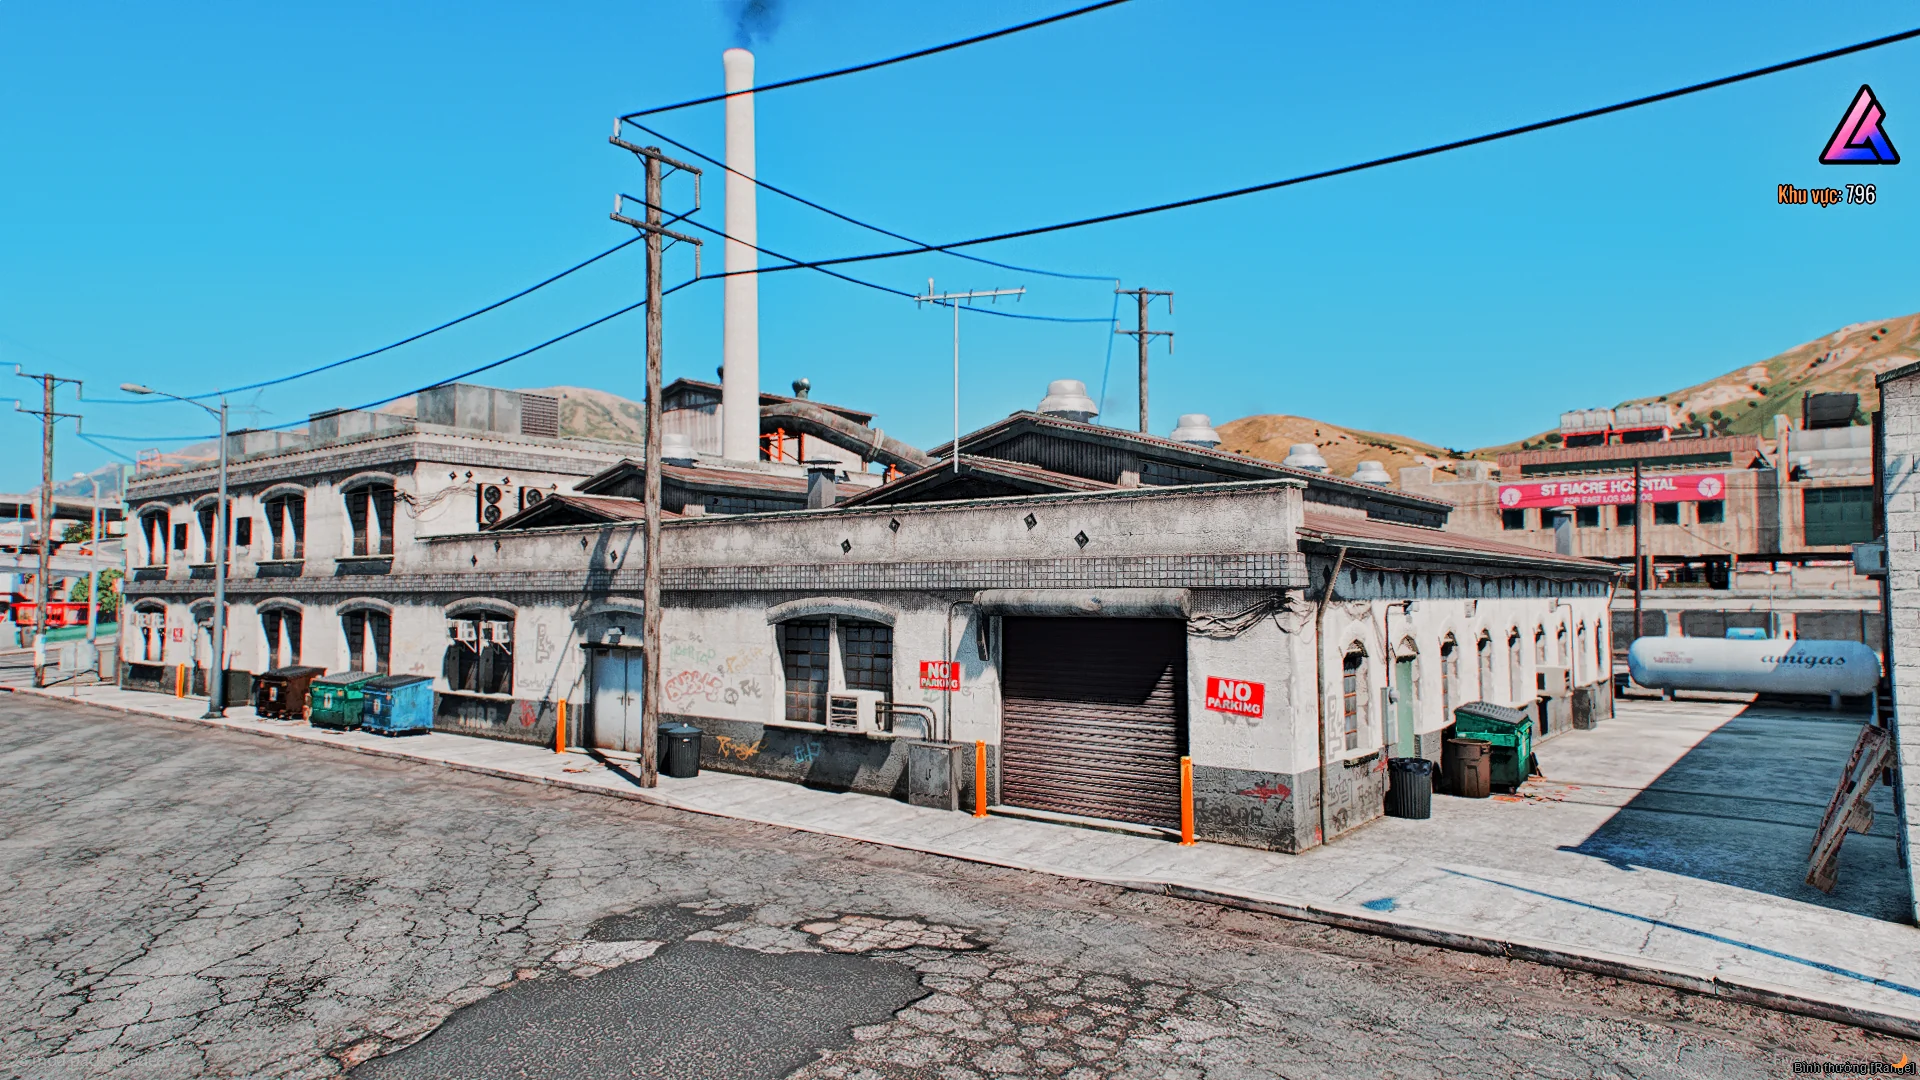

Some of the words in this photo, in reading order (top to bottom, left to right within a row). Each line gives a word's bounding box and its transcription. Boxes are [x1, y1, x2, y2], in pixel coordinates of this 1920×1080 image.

[1541, 484, 1557, 496] ST
[1560, 481, 1608, 495] FIACRE
[1563, 497, 1580, 505] FOR
[1582, 495, 1600, 504] EAST
[1603, 494, 1619, 503] LOS
[928, 662, 951, 679] NO
[1218, 679, 1252, 701] NO
[1207, 696, 1260, 714] PARKING
